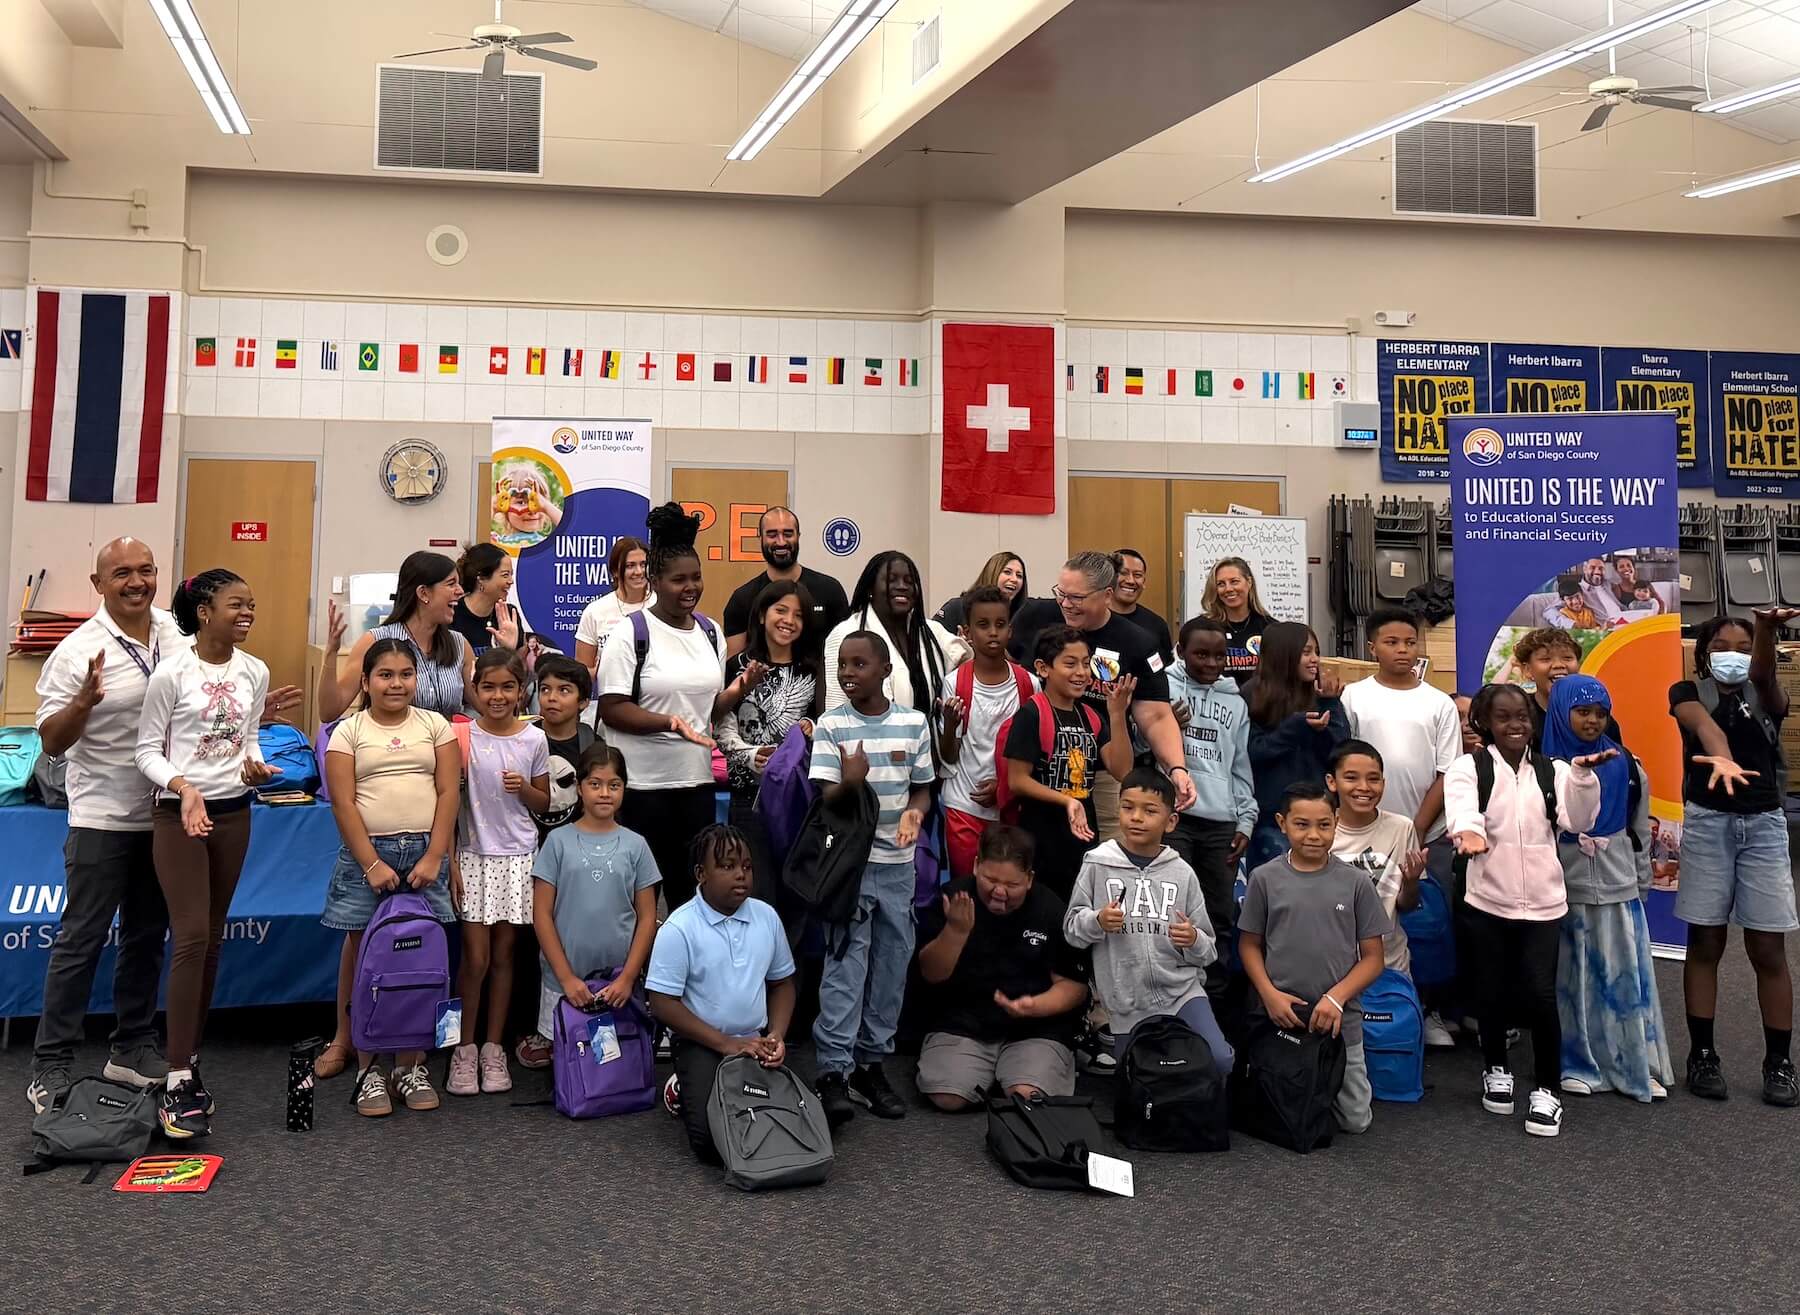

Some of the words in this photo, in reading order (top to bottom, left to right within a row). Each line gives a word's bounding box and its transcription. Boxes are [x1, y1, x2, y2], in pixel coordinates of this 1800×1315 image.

[1385, 343, 1437, 355] HERBERT
[1439, 344, 1480, 356] IBARRA
[1396, 358, 1470, 371] ELEMENTARY
[1508, 354, 1549, 366] Herbert
[1551, 355, 1582, 367] Ibarra
[1642, 354, 1668, 364] Ibarra
[1631, 365, 1681, 379] Elementary
[1731, 370, 1762, 381] Herbert
[1764, 371, 1789, 381] Ibarra
[1722, 382, 1769, 394] Elementary
[1771, 384, 1798, 394] School
[1398, 378, 1436, 415] NO
[1438, 379, 1469, 400] place
[1511, 382, 1549, 412] NO
[1551, 384, 1581, 403] place
[1621, 384, 1656, 411] NO
[1658, 385, 1689, 405] place
[1441, 399, 1471, 416] for
[1728, 398, 1763, 432] NO
[1764, 399, 1793, 418] place
[1768, 418, 1795, 433] for
[581, 430, 613, 441] UNITED
[614, 431, 634, 441] WAY
[1399, 417, 1449, 450] HAT
[1506, 431, 1552, 447] UNITED
[1554, 431, 1583, 446] WAY
[581, 443, 588, 451] of
[589, 443, 600, 451] San
[601, 443, 621, 452] Diego
[621, 444, 644, 453] County
[1729, 434, 1797, 466] HATE
[1507, 450, 1517, 459] of
[1518, 451, 1536, 460] San
[1537, 451, 1565, 462] Diego
[1566, 451, 1599, 462] County
[1465, 478, 1533, 505] UNITED
[1542, 478, 1561, 505] IS
[1567, 478, 1603, 505] THE
[1465, 512, 1478, 523] to
[1482, 512, 1557, 524] Educational
[1561, 512, 1614, 524] Success
[241, 523, 257, 531] UPS
[236, 532, 262, 540] INSIDE
[1465, 529, 1489, 540] and
[1493, 528, 1550, 541] Financial
[1554, 529, 1608, 544] Security
[555, 535, 607, 558] UNITED
[554, 563, 580, 585] THE
[585, 563, 611, 585] WA
[554, 594, 564, 604] to
[554, 607, 582, 617] Succe
[1104, 876, 1179, 922] GAP
[3, 924, 32, 950] of
